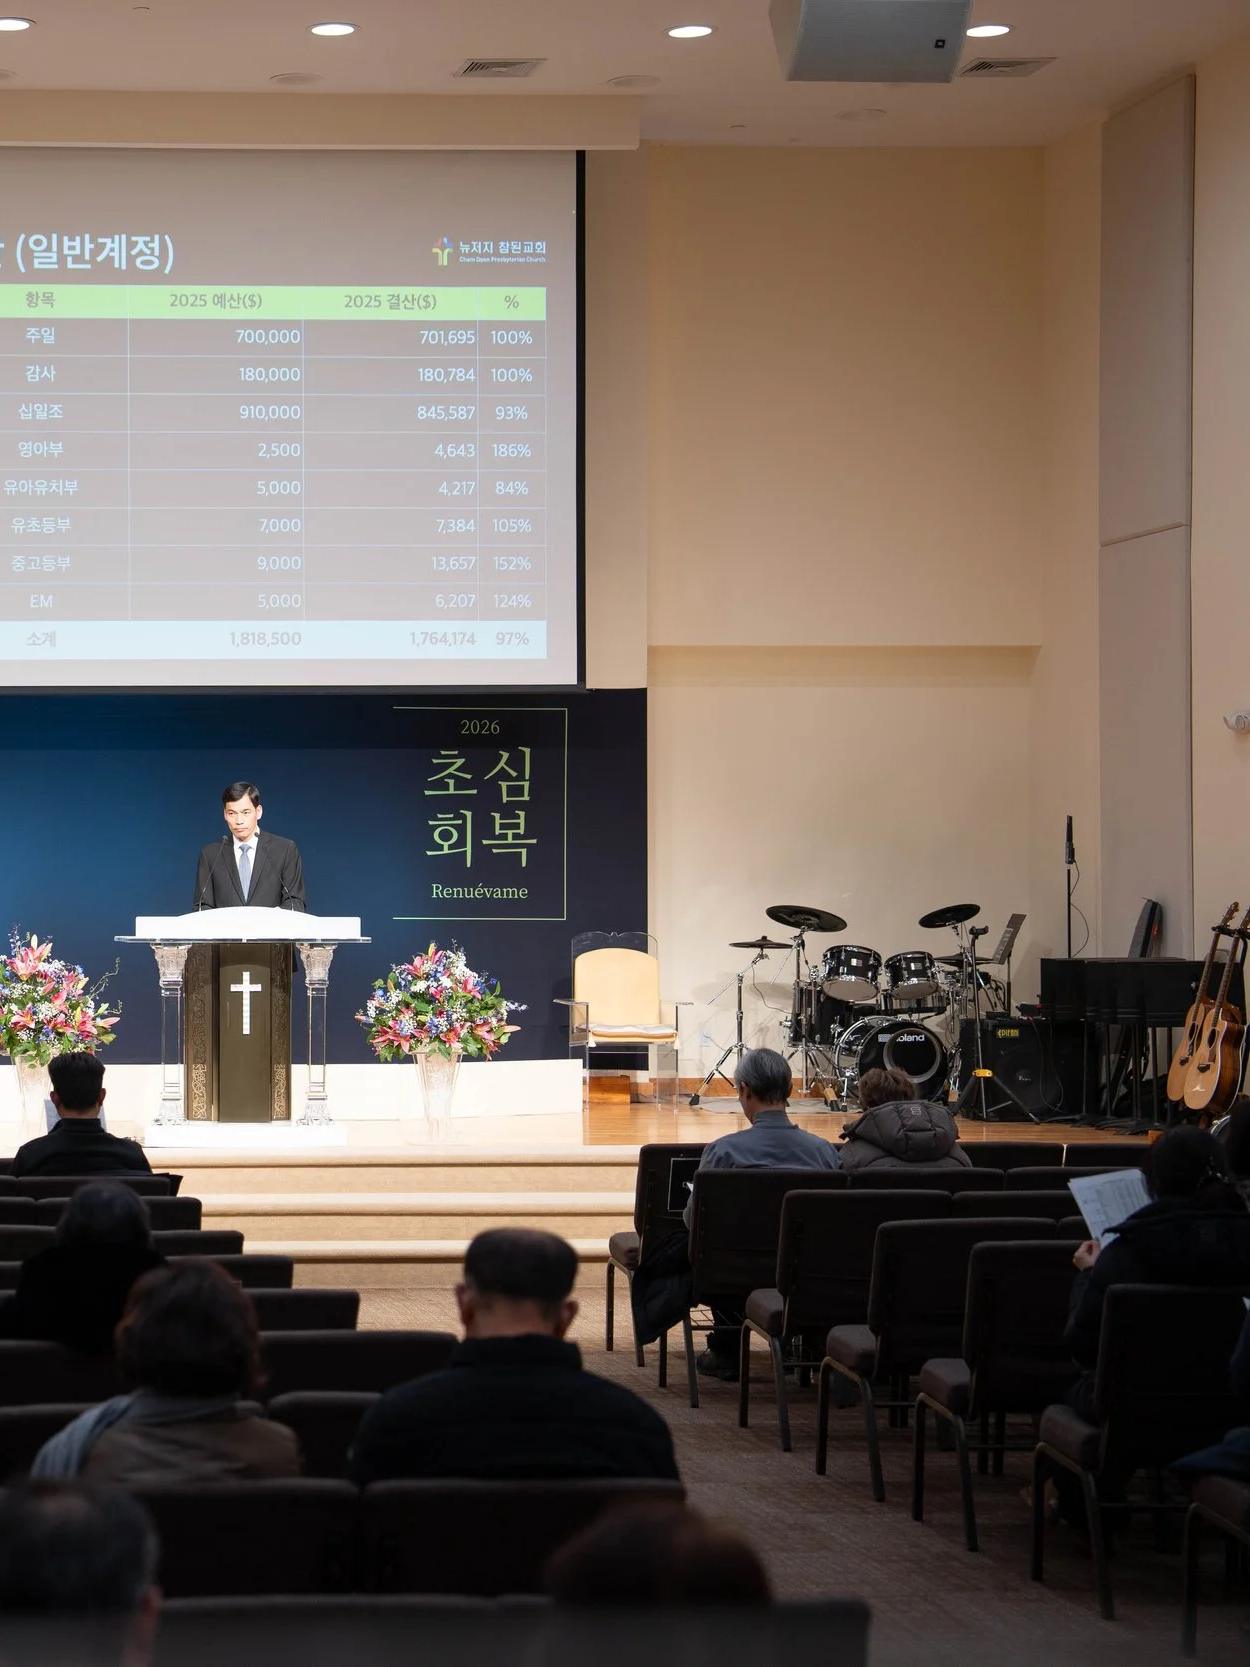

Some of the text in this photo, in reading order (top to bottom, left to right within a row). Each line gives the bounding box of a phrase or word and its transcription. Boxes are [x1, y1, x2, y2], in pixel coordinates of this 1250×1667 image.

[16, 233, 173, 274] (일반계정)
[460, 241, 546, 254] 뉴저지 참된교회
[25, 291, 55, 308] 항목
[170, 293, 262, 309] 2025 예산($)
[344, 293, 437, 310] 2025 결산($)
[504, 295, 519, 309] %
[26, 327, 55, 344] 주일
[236, 329, 300, 345] 700,000
[420, 330, 475, 346] 701,695
[491, 330, 533, 344] 100%
[26, 365, 56, 382] 감사
[239, 367, 300, 383] 180,000
[418, 368, 475, 383] 180,784
[491, 368, 533, 382] 100%
[19, 403, 63, 420] 십일조
[240, 405, 301, 421] 910,000
[417, 406, 475, 421] 845,587
[495, 406, 528, 420] 93%
[18, 441, 63, 458] 영아부
[258, 443, 301, 459] 2,500
[434, 444, 475, 459] 4,643
[492, 444, 531, 457] 186%
[3, 479, 79, 496] 유아유치부
[257, 481, 301, 496] 5,000
[438, 481, 476, 496] 4,217
[495, 481, 529, 495] 84%
[11, 517, 71, 534] 유초등부
[259, 518, 301, 534] 7,000
[436, 519, 476, 534] 7,384
[493, 518, 532, 533] 105%
[11, 555, 71, 572] 중고등부
[257, 556, 301, 571] 9,000
[432, 556, 476, 572] 13,657
[493, 556, 531, 570] 152%
[30, 594, 53, 608] EM
[258, 594, 301, 609] 5,000
[435, 593, 476, 609] 6,207
[494, 594, 532, 608] 124%
[26, 631, 56, 648] 소계
[230, 631, 301, 647] 1,818,500
[410, 631, 476, 647] 1,764,174
[496, 632, 530, 646] 97%
[461, 720, 500, 734] 2026
[432, 883, 528, 899] Renuévame
